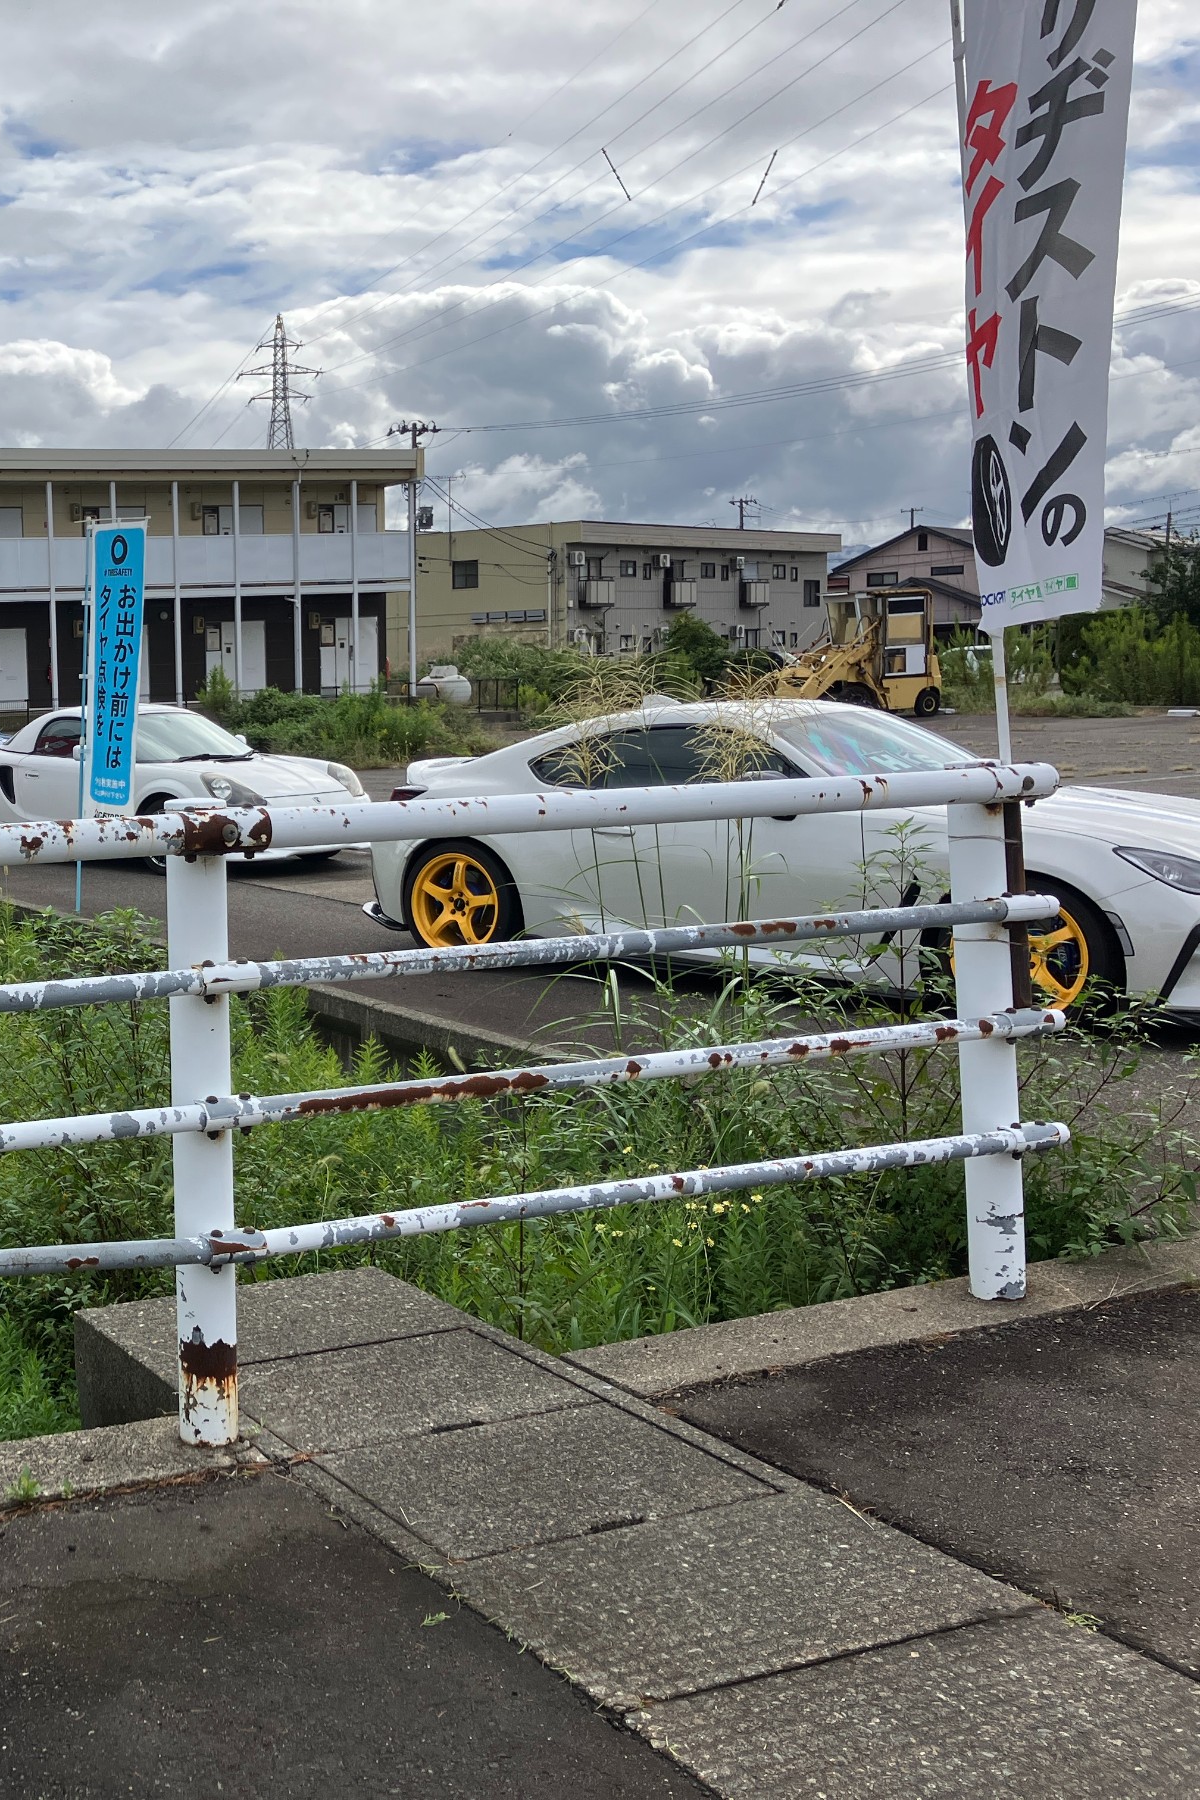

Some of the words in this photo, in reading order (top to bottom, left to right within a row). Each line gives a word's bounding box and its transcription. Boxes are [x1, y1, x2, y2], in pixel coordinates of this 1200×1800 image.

[964, 79, 1018, 419] タイヤ
[97, 585, 112, 737] タイヤ点検を
[106, 584, 137, 769] お出かけ前には
[980, 591, 1006, 607] OCKPIT
